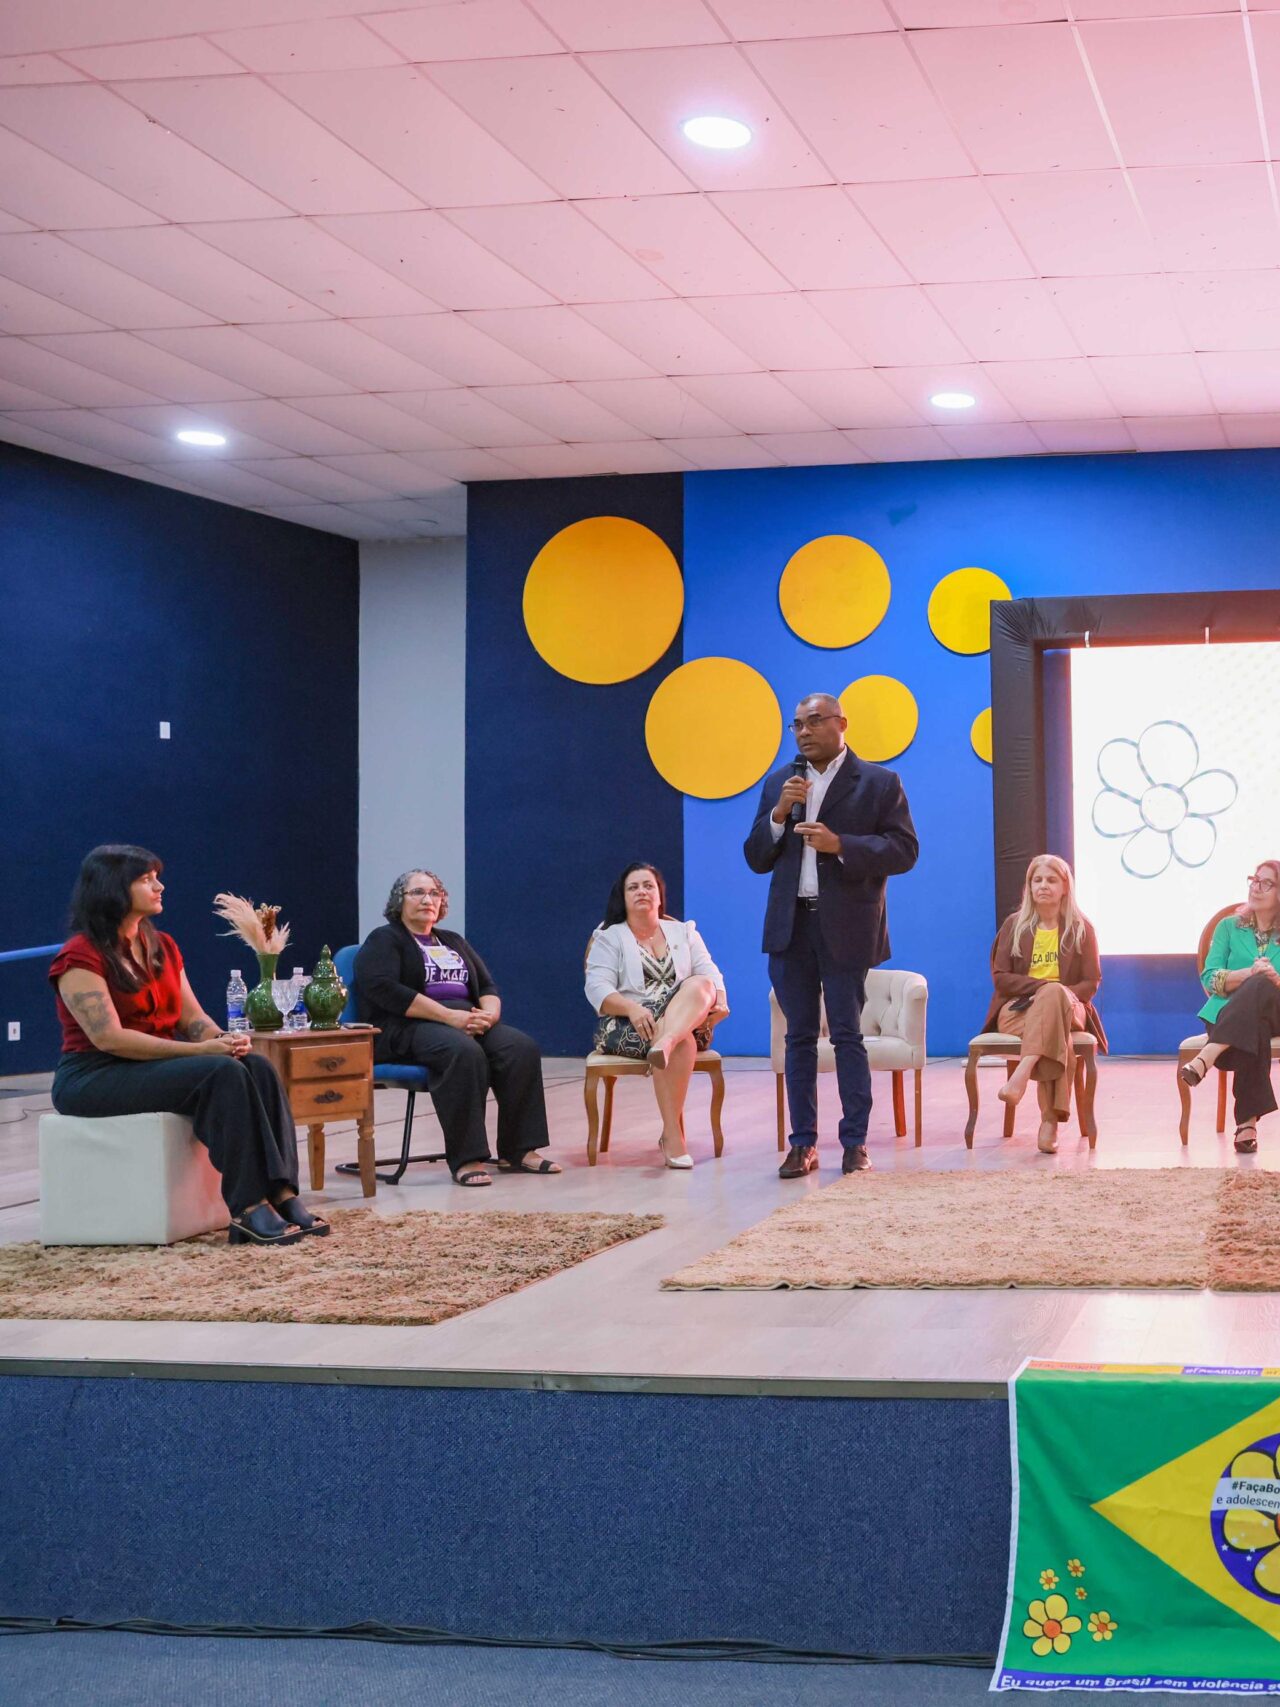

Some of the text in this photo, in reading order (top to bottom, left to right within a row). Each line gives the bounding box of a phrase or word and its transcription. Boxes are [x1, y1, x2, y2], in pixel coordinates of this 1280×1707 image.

[1216, 1496, 1223, 1504] e
[1001, 1675, 1021, 1687] Eu
[1104, 1677, 1151, 1686] Brasil
[1192, 1679, 1264, 1690] violência
